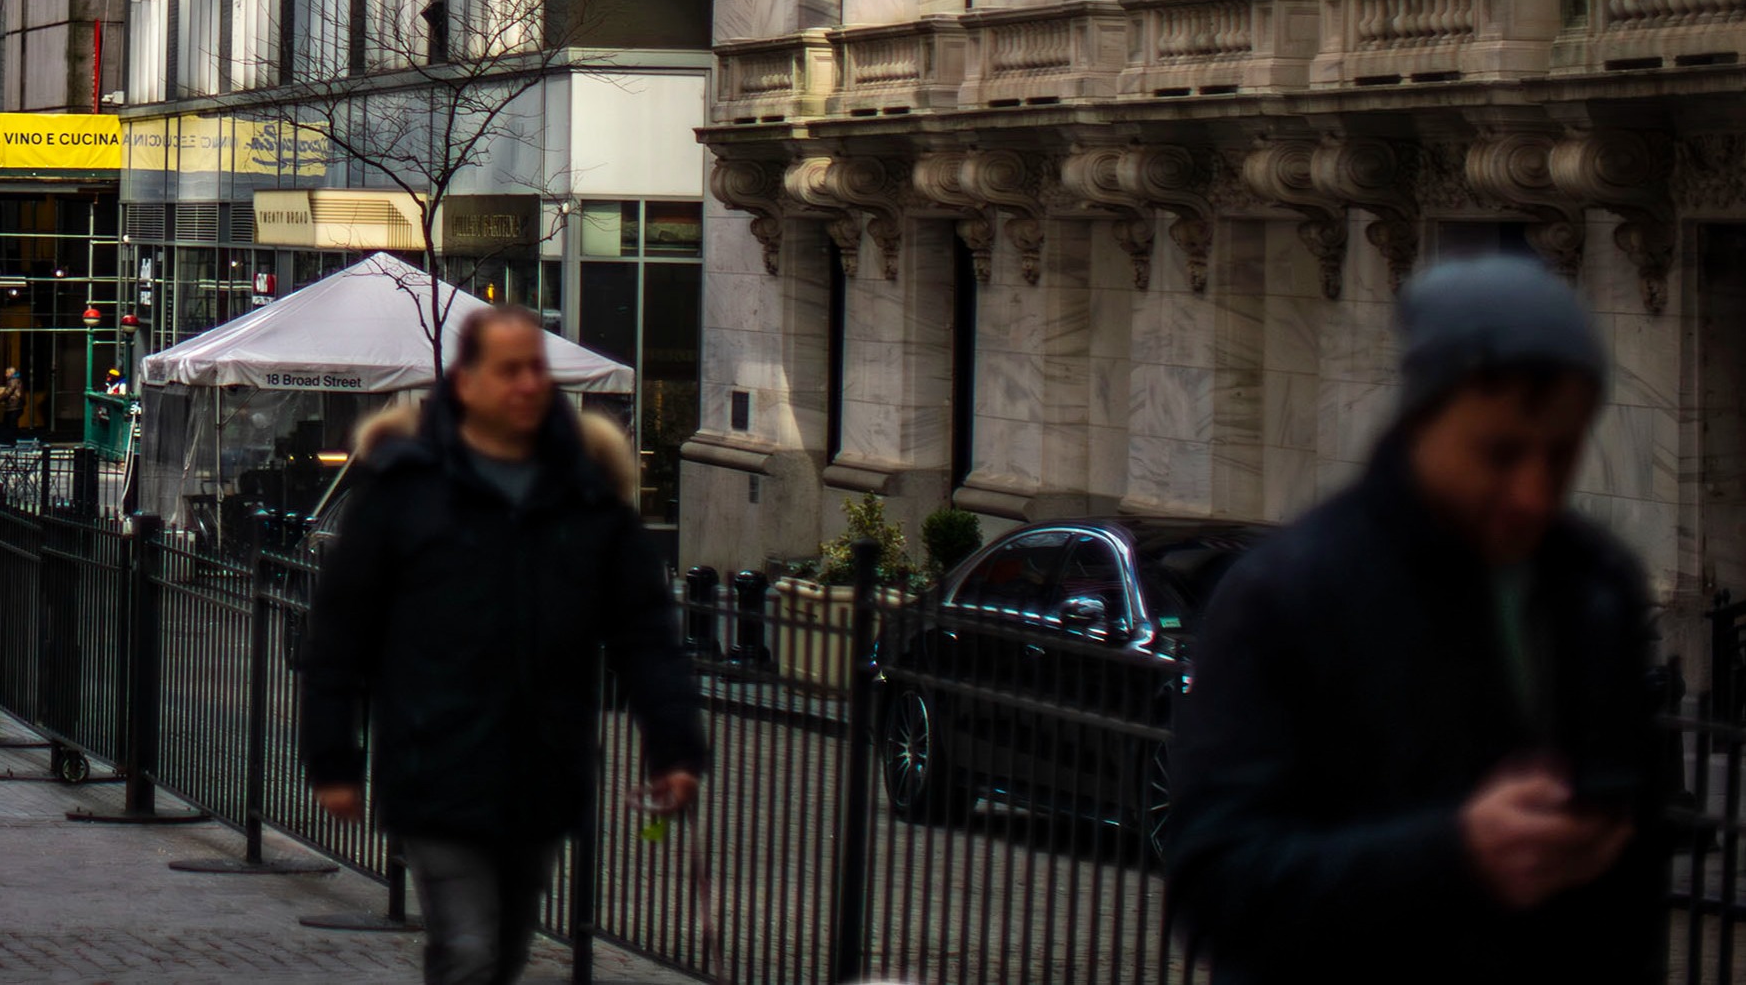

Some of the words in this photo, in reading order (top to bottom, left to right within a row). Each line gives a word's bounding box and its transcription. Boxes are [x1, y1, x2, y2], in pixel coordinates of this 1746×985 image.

[4, 132, 43, 146] VINO
[47, 133, 55, 146] E
[59, 132, 120, 146] CUCINA
[259, 210, 284, 224] TWENTY
[286, 210, 309, 225] BROAD
[265, 373, 280, 386] 18
[282, 374, 321, 387] Broad
[323, 374, 362, 388] Street
